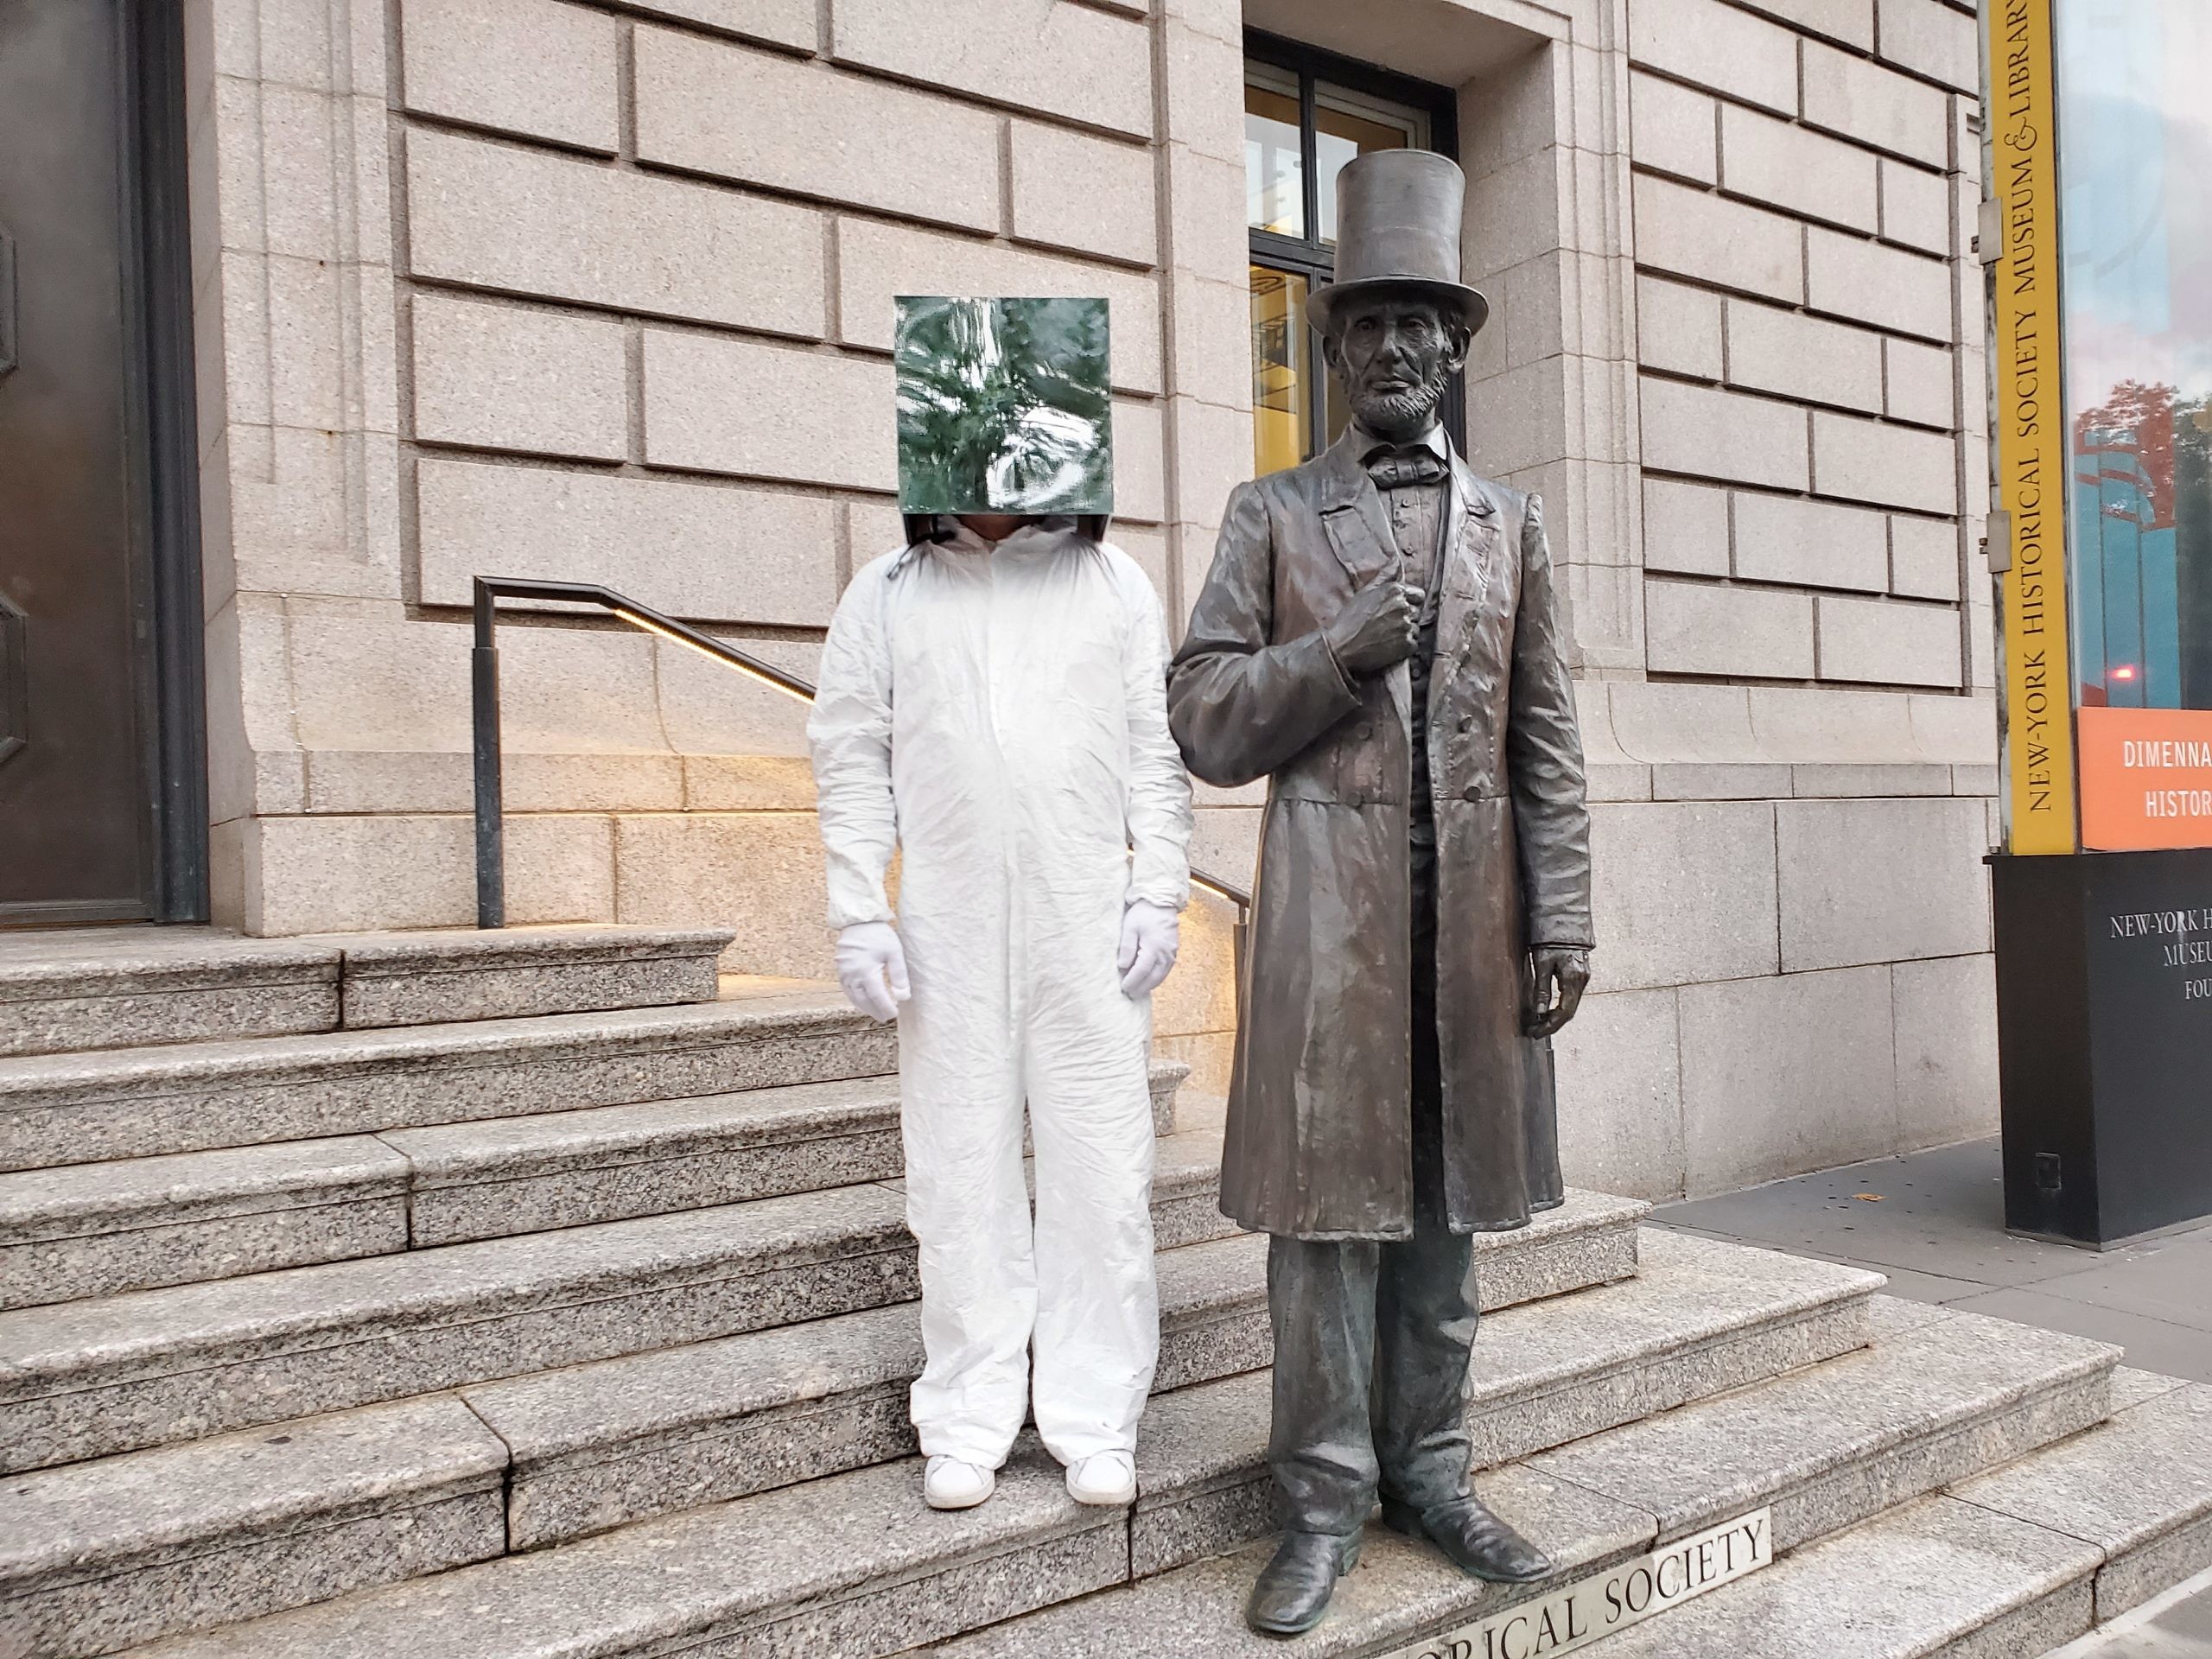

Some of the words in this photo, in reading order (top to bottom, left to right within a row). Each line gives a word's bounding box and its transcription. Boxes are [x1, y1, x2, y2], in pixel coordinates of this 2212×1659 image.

[2005, 0, 2031, 118] LIBRAR
[2004, 116, 2038, 153] &
[2011, 156, 2037, 296] MUSEUM
[2014, 309, 2039, 438] SOCIETY
[2017, 448, 2044, 636] HISTORICAL
[2024, 649, 2051, 812] NEW-YORK
[2123, 740, 2212, 768] DIMENNA
[2145, 789, 2212, 817] HISTOR
[2110, 910, 2199, 938] NEW-YORK
[2184, 977, 2212, 1000] FOU
[1417, 1595, 1588, 1659] ICAL
[1605, 1518, 1764, 1624] SOCIETY
